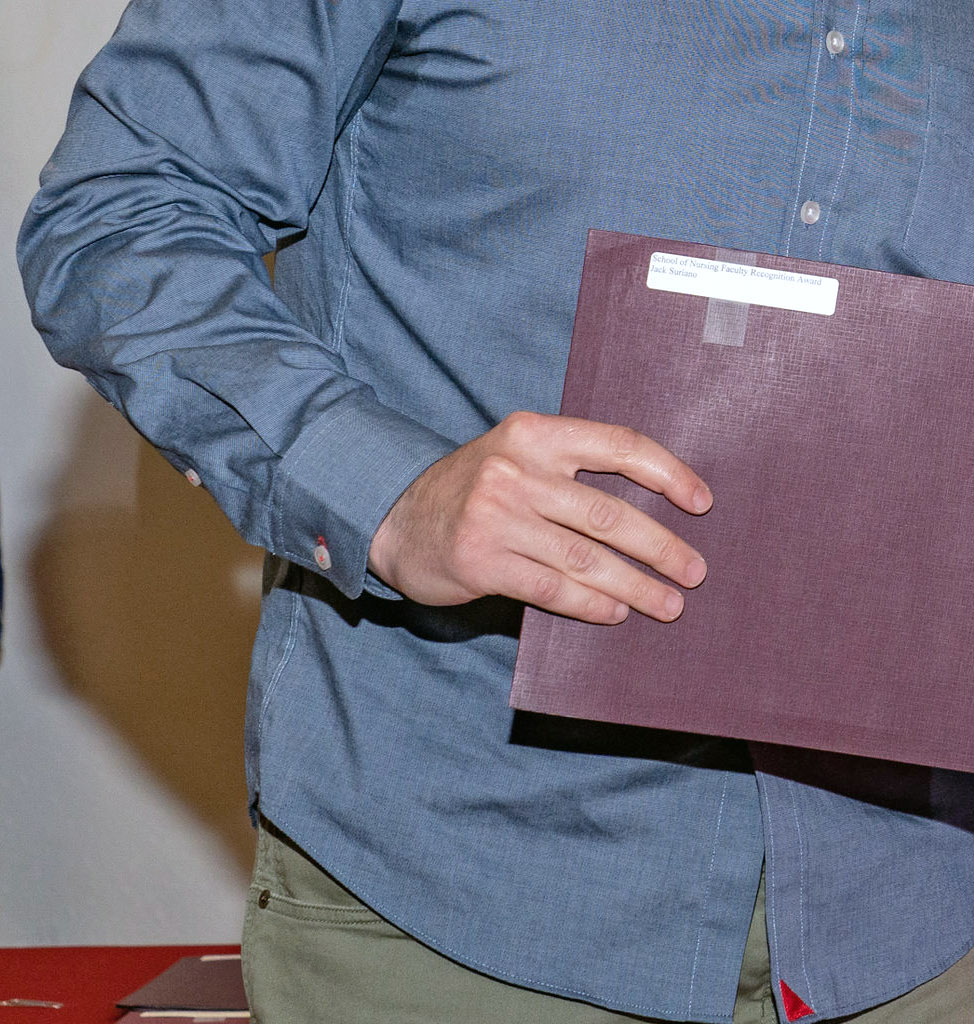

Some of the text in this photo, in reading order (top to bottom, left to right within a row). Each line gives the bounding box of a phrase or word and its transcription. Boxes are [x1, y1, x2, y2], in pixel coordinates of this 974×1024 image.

[650, 264, 667, 274] Jack
[652, 254, 822, 286] School of Nursing Faculty Recognition Award
